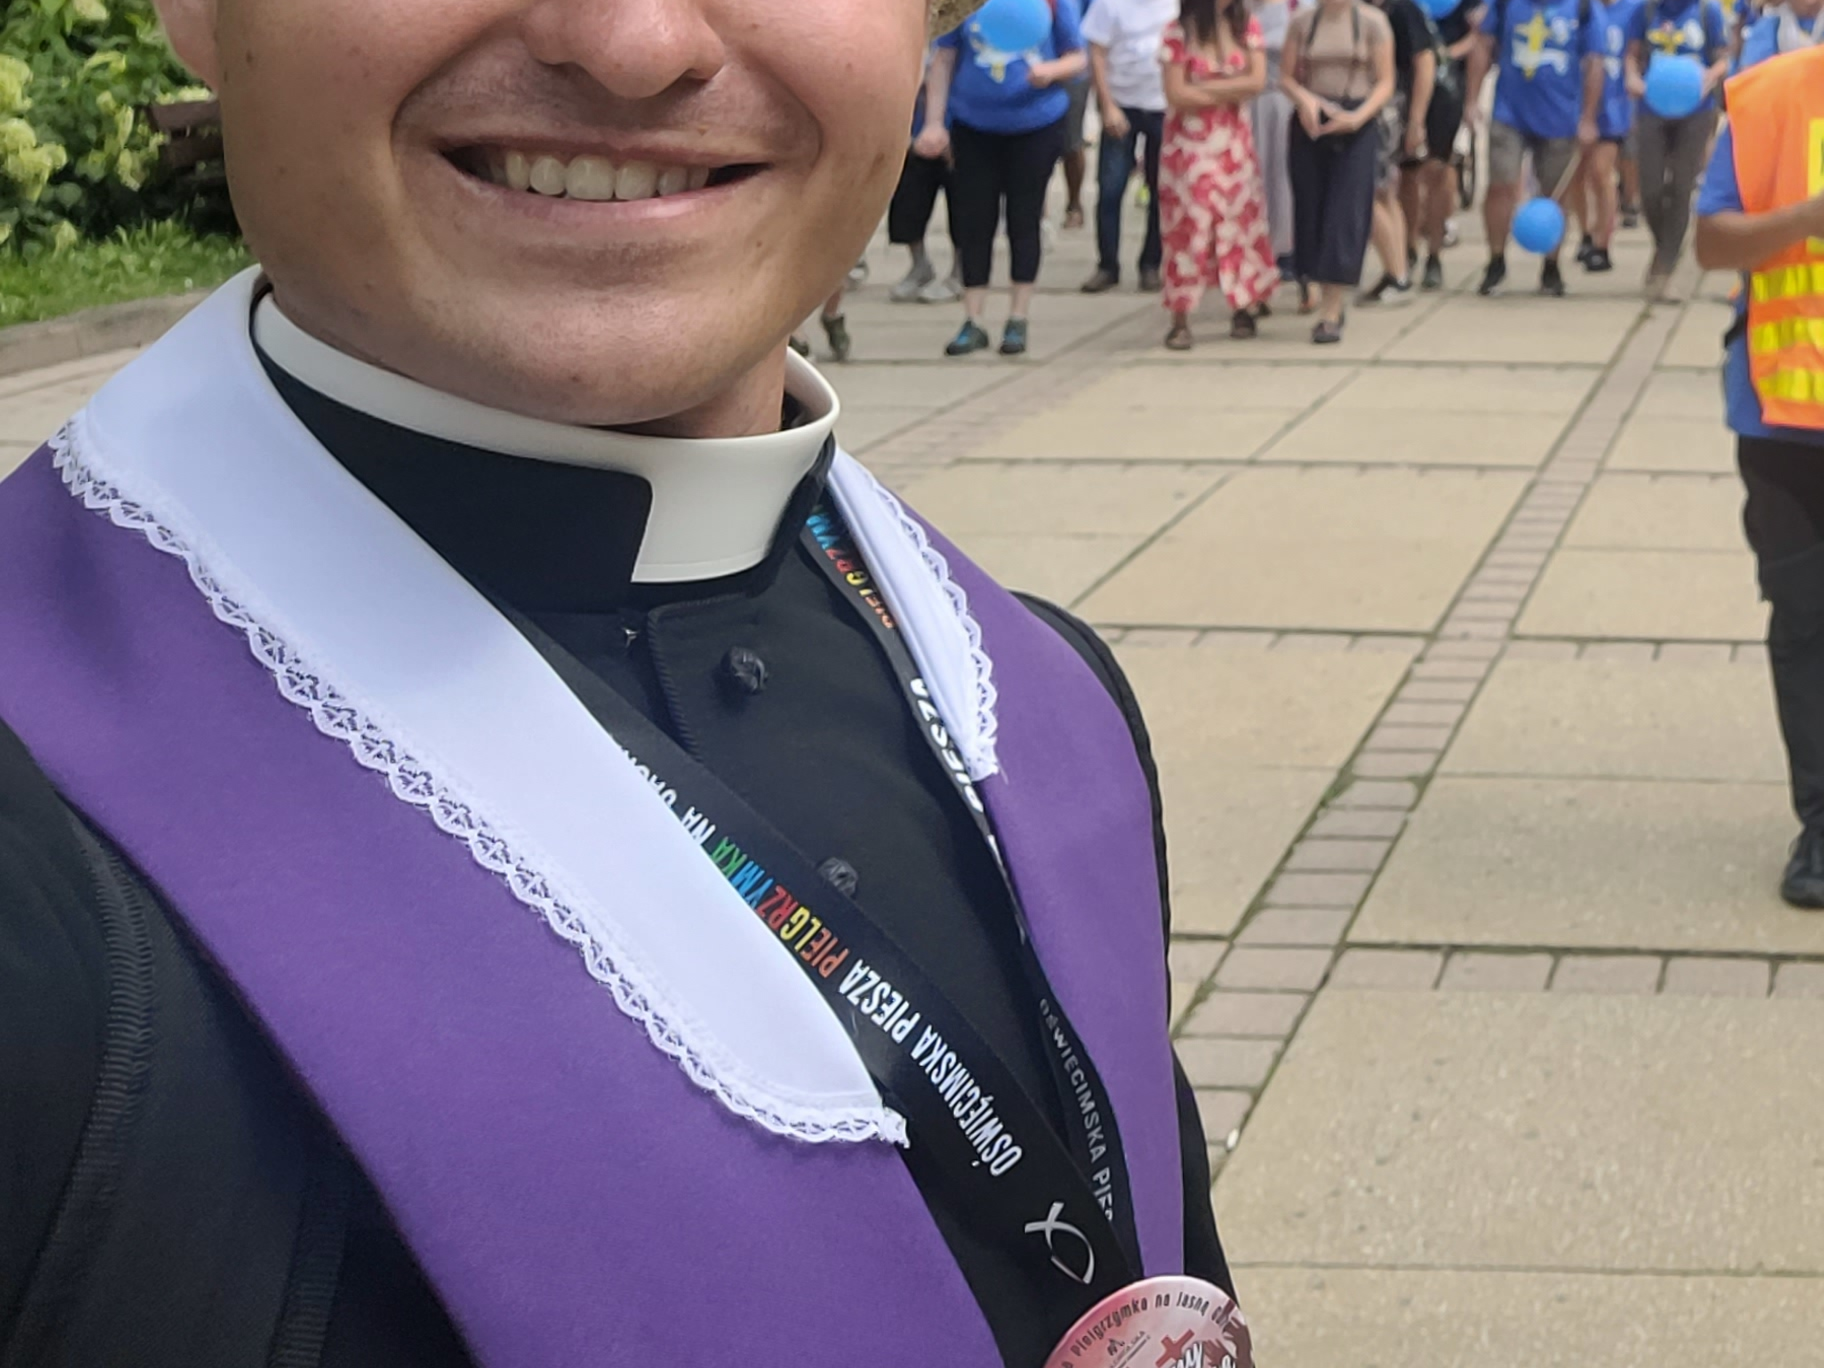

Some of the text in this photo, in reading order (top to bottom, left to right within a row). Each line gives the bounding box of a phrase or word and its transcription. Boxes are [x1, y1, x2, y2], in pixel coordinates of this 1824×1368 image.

[681, 806, 716, 845] NA
[711, 836, 849, 979] PIELGRZYMKA
[838, 959, 921, 1044] PIESZA
[909, 1025, 1023, 1176] OŚWIĘCIMSKA
[1155, 1293, 1170, 1308] na
